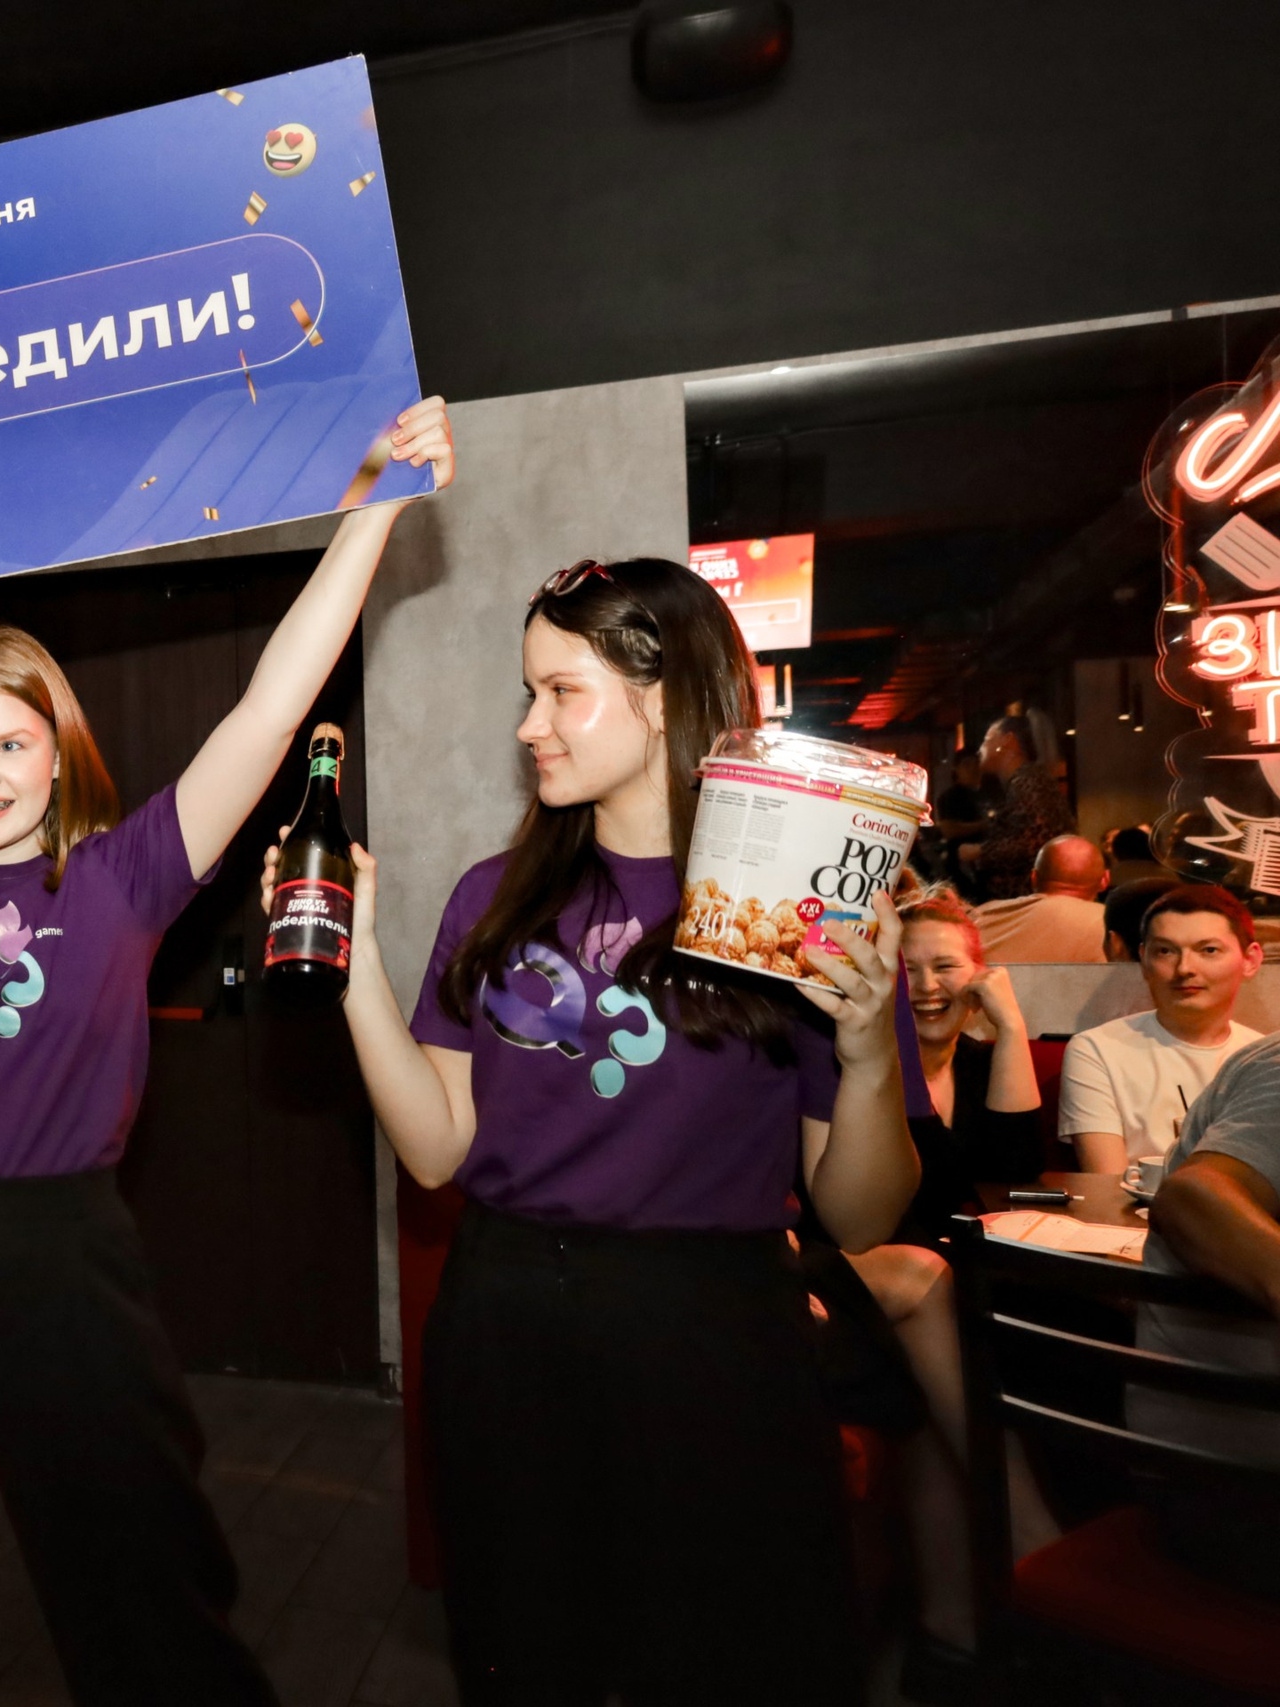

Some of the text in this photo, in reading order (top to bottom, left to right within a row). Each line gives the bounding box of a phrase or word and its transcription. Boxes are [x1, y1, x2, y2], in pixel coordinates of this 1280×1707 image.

[852, 812, 909, 843] CorinCorn
[836, 836, 901, 881] POP
[688, 905, 727, 940] 240
[799, 902, 821, 914] XXL
